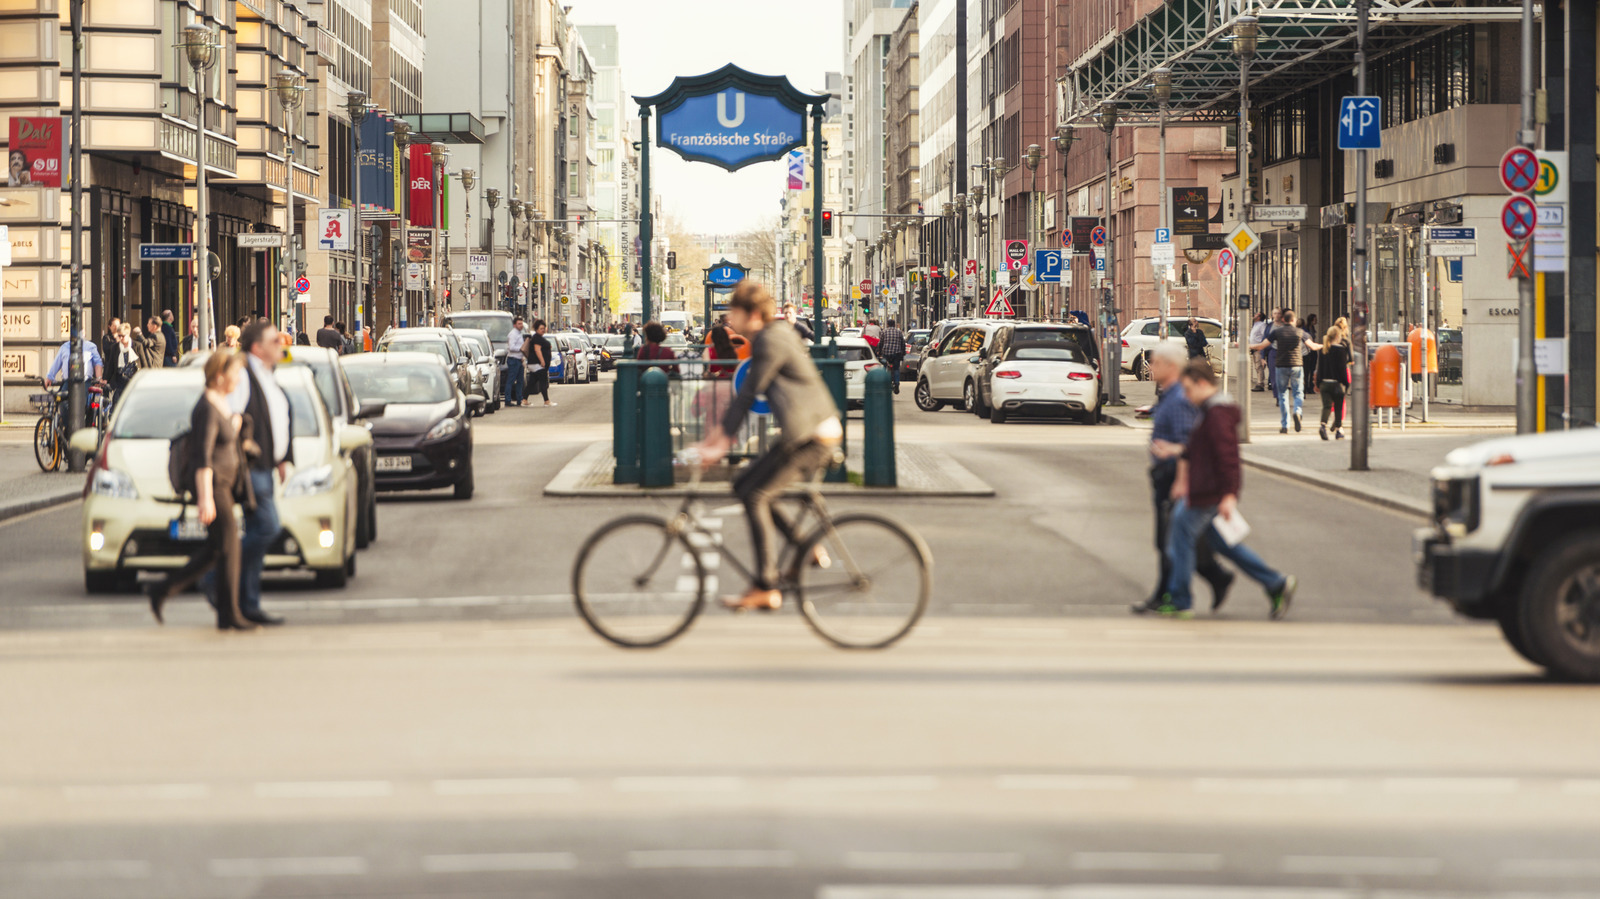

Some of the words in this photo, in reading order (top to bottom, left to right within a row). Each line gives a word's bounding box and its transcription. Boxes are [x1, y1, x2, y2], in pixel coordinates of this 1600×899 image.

[717, 93, 745, 128] U
[1360, 110, 1375, 136] P
[18, 118, 54, 140] Dalí
[670, 132, 750, 146] Französische
[753, 132, 794, 146] Straße
[411, 180, 431, 190] DER
[621, 180, 628, 190] LE
[1259, 208, 1300, 218] Jägerstraße
[243, 236, 277, 244] Jägerstraße
[1047, 256, 1059, 272] P
[723, 268, 731, 278] U
[2, 280, 32, 290] NT
[1489, 308, 1520, 316] ESCAD
